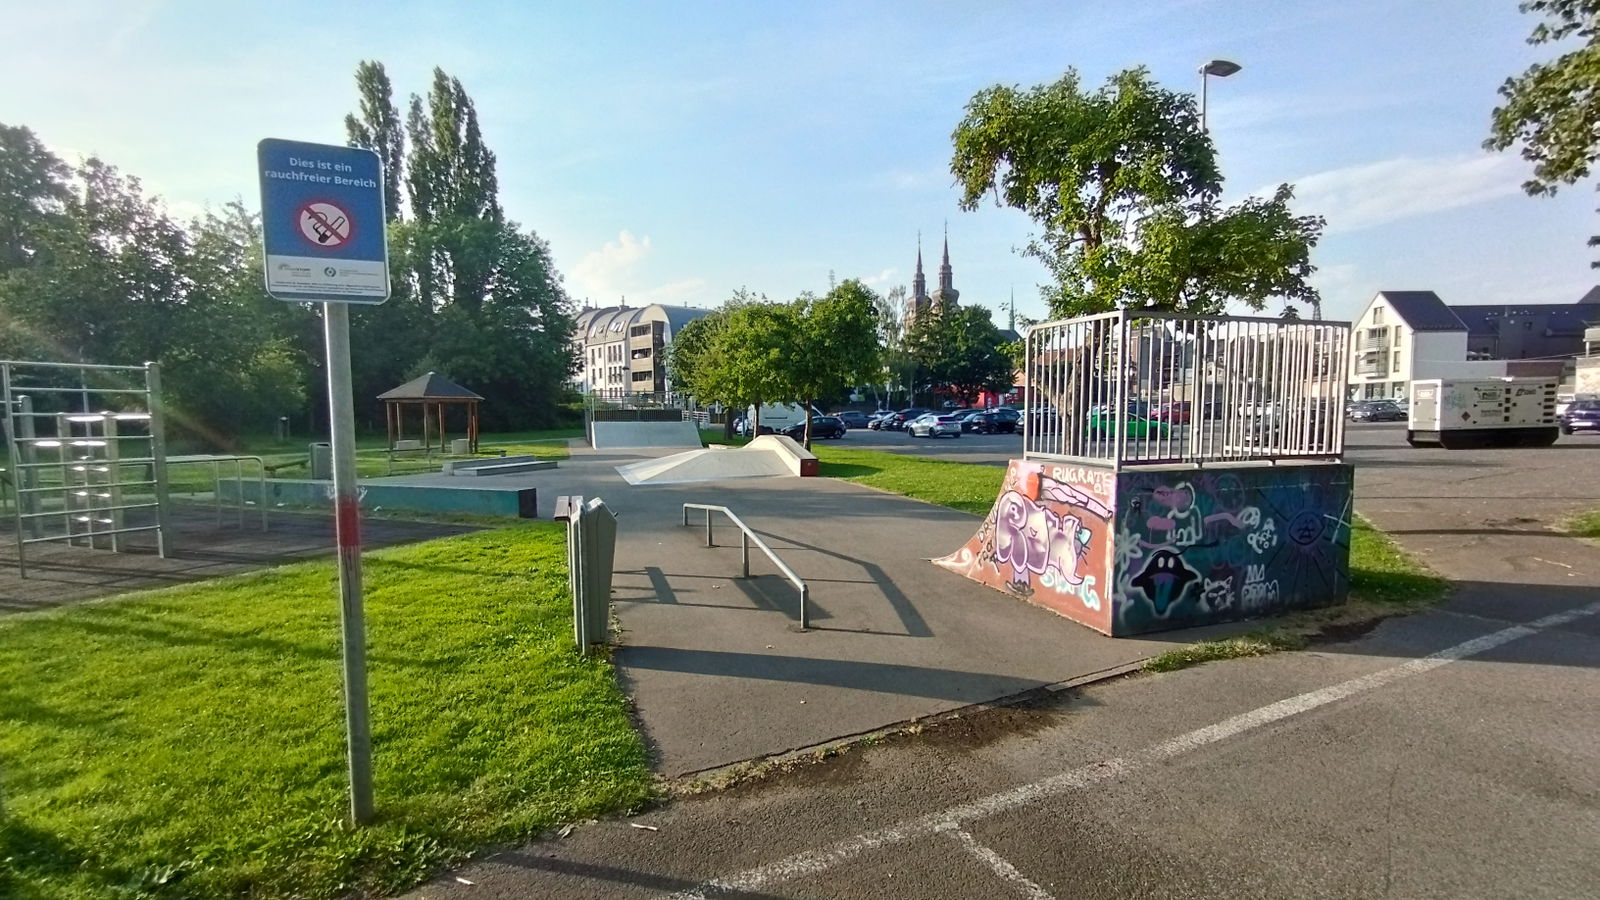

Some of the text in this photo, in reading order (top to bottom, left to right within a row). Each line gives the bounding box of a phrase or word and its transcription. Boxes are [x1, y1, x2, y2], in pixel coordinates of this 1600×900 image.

[289, 157, 352, 172] Dies ist ein
[264, 170, 377, 188] rauchfreier Bereich
